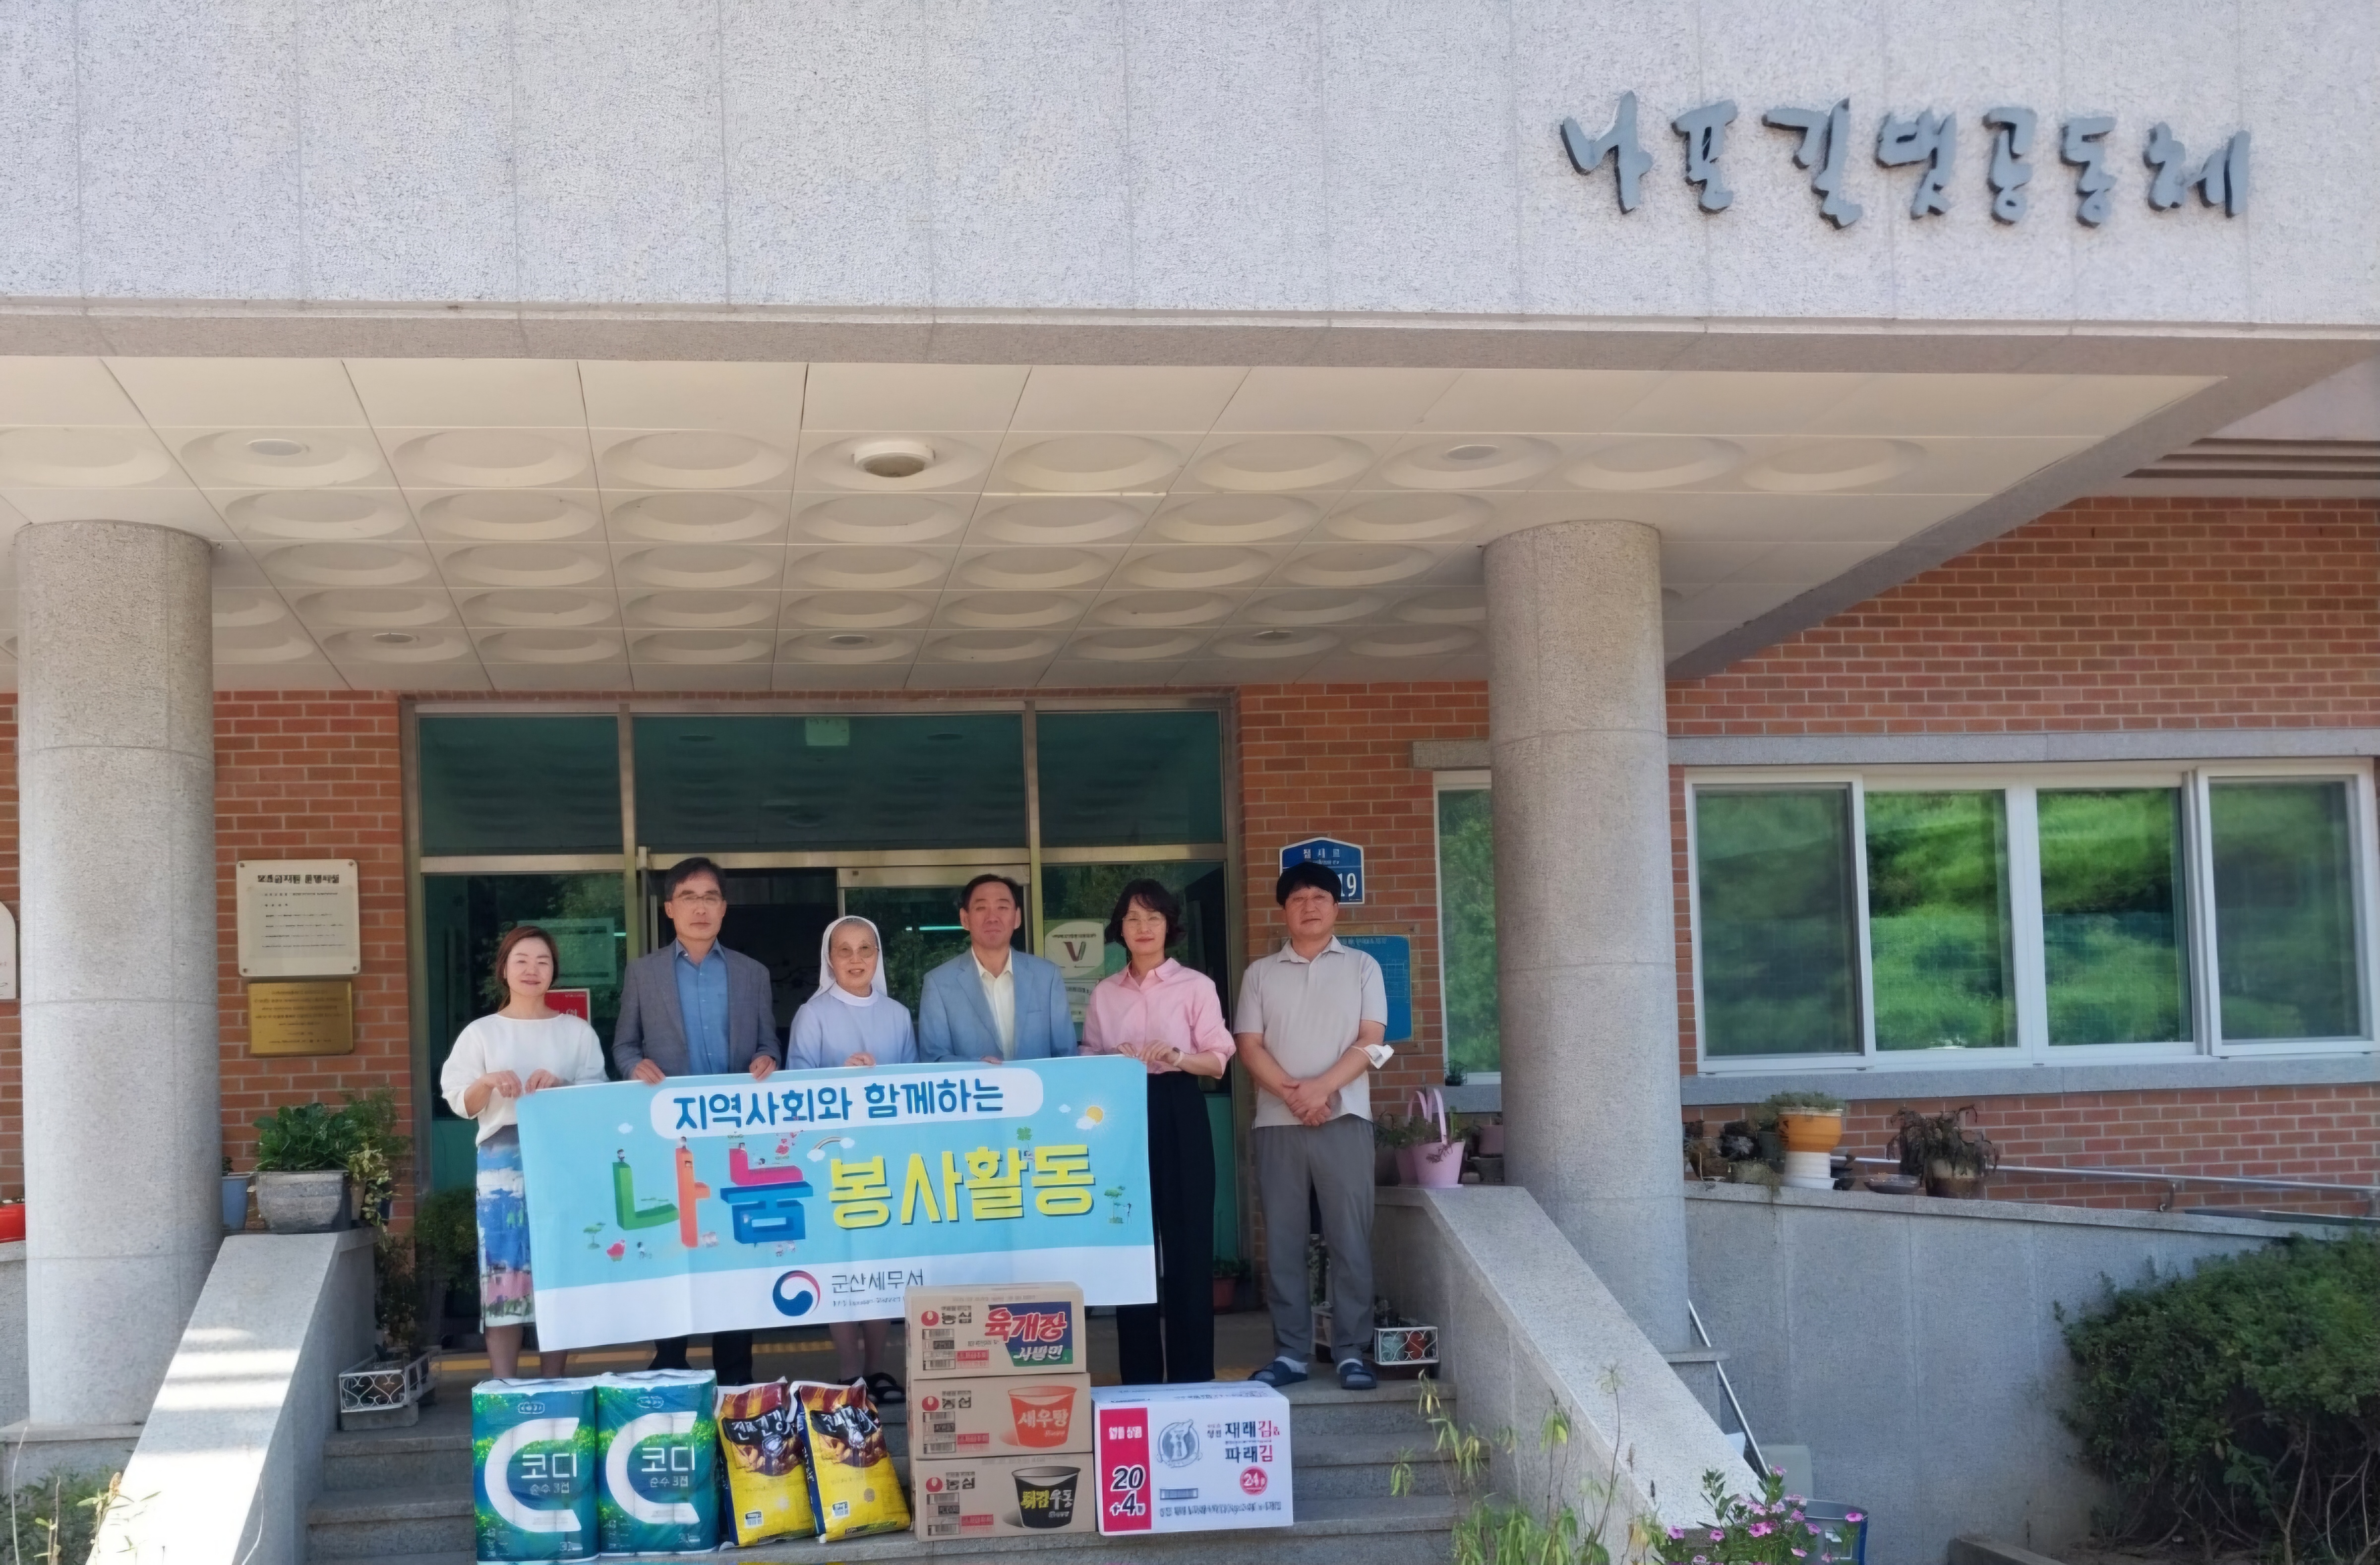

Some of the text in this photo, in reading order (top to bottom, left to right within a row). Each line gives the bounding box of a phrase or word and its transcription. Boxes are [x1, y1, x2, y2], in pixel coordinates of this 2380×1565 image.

[673, 1078, 1004, 1130] 지역사회와 함께하는
[612, 1144, 814, 1249] 나눔
[828, 1144, 1095, 1229] 봉사활동
[832, 1268, 924, 1293] 군산세무서
[984, 1307, 1067, 1343] 육개장
[521, 1453, 577, 1479] 코디
[641, 1443, 695, 1472] 코디
[1225, 1445, 1273, 1463] 파래김
[1110, 1465, 1145, 1491] 20
